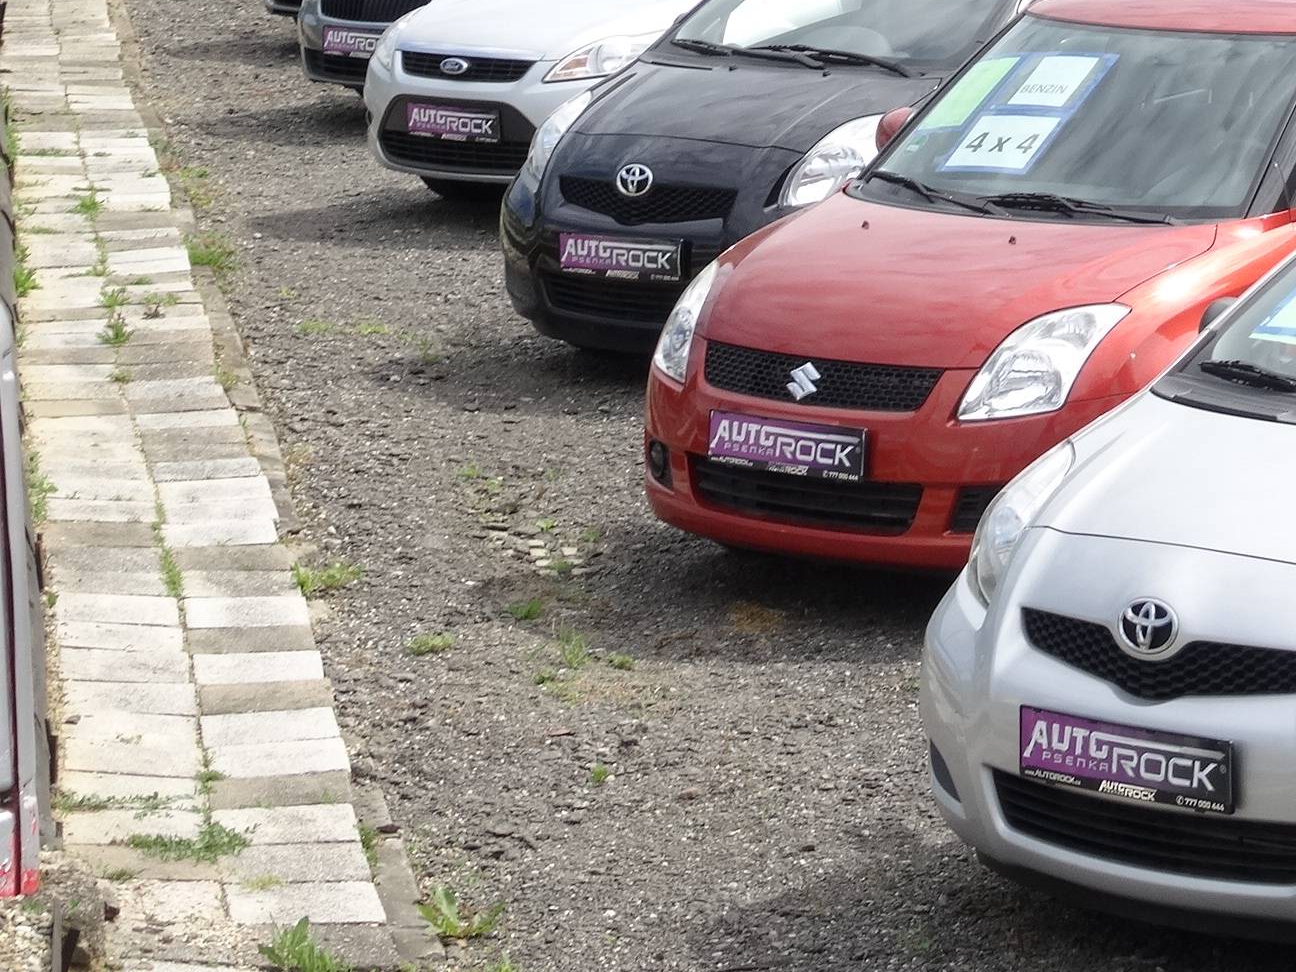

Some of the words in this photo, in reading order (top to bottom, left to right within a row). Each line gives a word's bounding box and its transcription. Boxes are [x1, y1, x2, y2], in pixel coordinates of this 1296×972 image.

[1020, 83, 1068, 94] BENZIN
[409, 107, 497, 134] AUTOROCK
[965, 132, 989, 153] 4
[1016, 134, 1040, 154] 4
[561, 238, 678, 270] AUTOROCK
[711, 419, 860, 467] AUTOROCK
[1023, 720, 1226, 791] AUTOROCK
